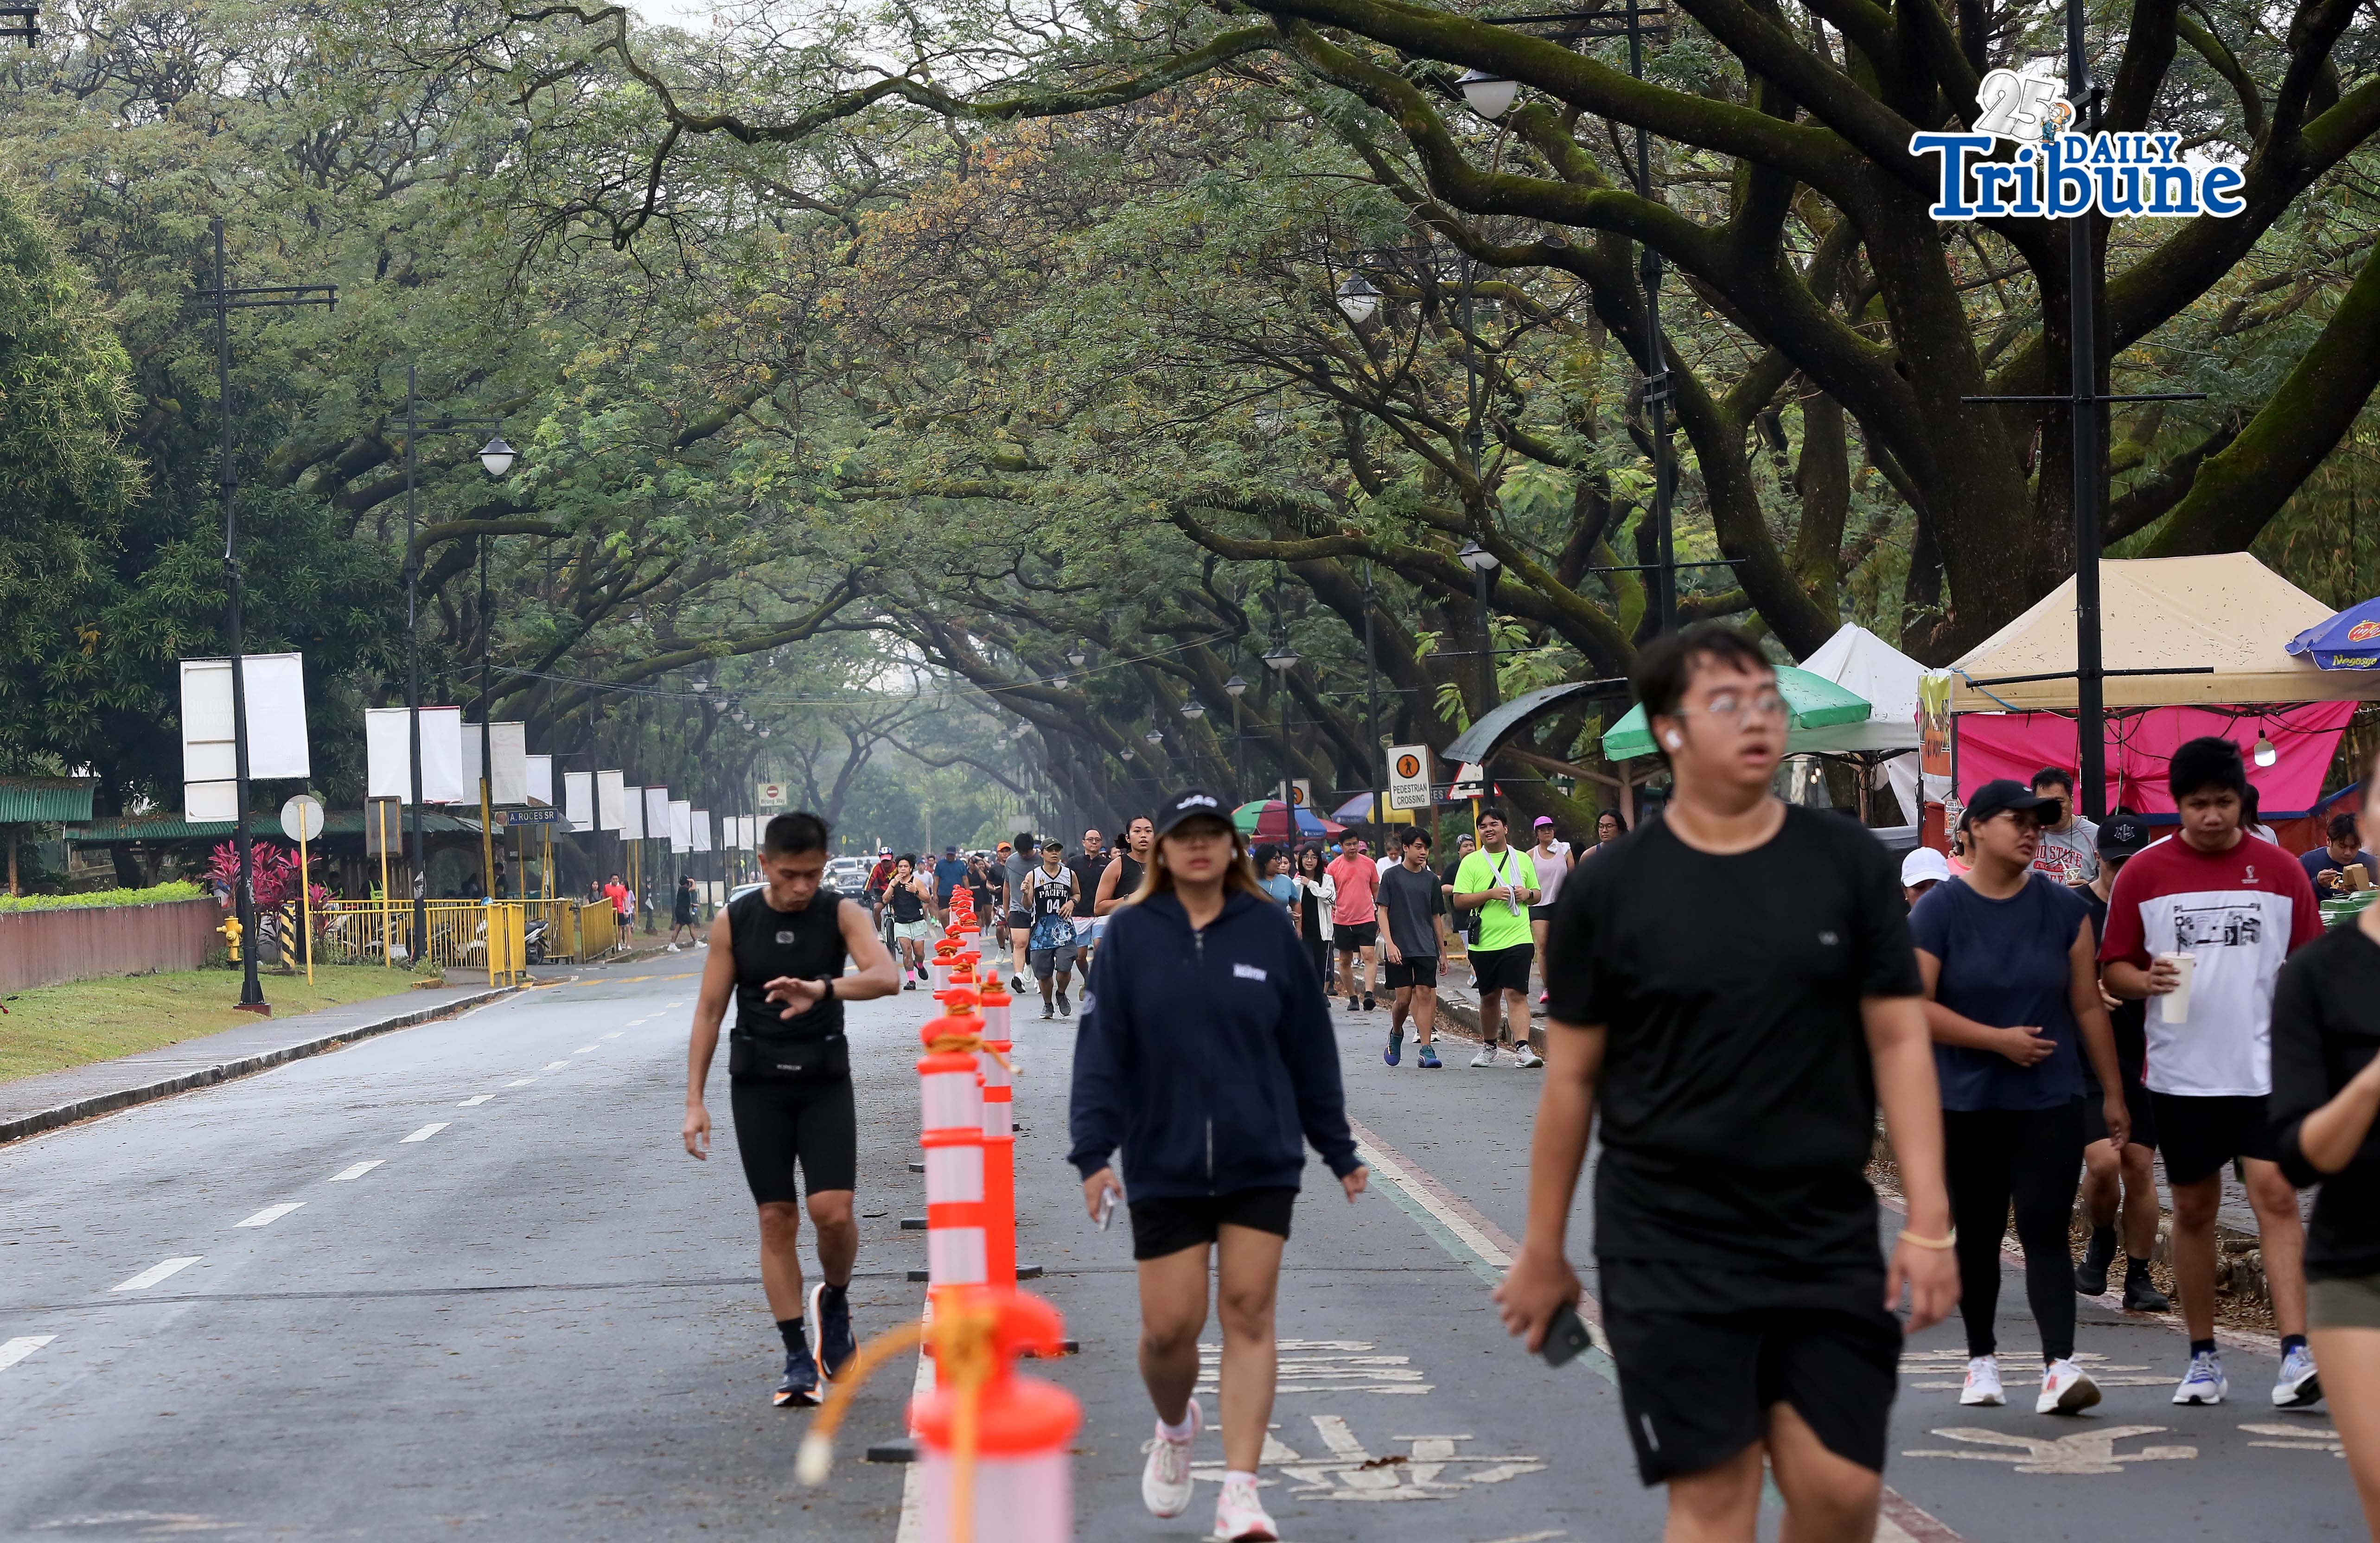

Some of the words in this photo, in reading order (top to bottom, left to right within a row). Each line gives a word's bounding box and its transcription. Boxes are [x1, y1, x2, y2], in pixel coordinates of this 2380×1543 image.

[2333, 654, 2377, 667] Negosyo
[1393, 782, 1427, 792] PEDESTRIAN
[1397, 795, 1425, 805] CROSSING
[518, 811, 543, 821] ROCES
[544, 811, 554, 819] SR
[2050, 846, 2082, 868] STATE
[1039, 889, 1067, 899] PACIFIC
[1046, 899, 1060, 913] 04
